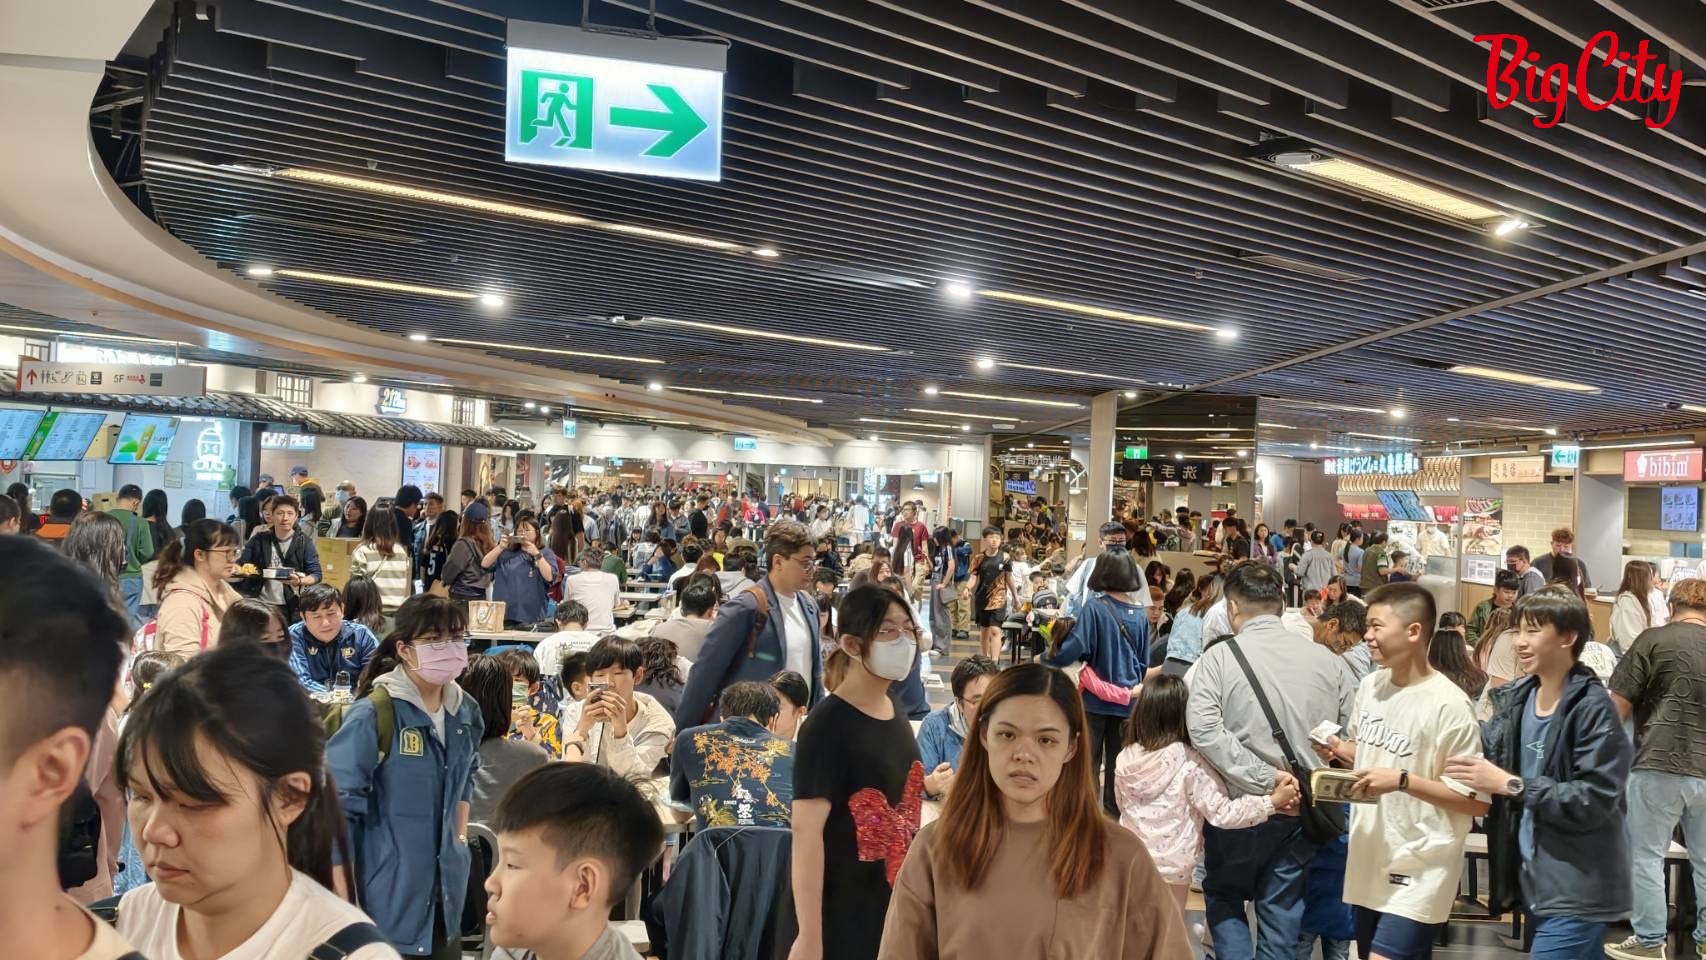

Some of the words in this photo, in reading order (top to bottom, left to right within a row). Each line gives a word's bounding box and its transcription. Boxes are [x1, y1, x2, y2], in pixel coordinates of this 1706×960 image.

[113, 374, 125, 383] 5F
[1649, 455, 1689, 477] bibim
[427, 551, 436, 576] 5
